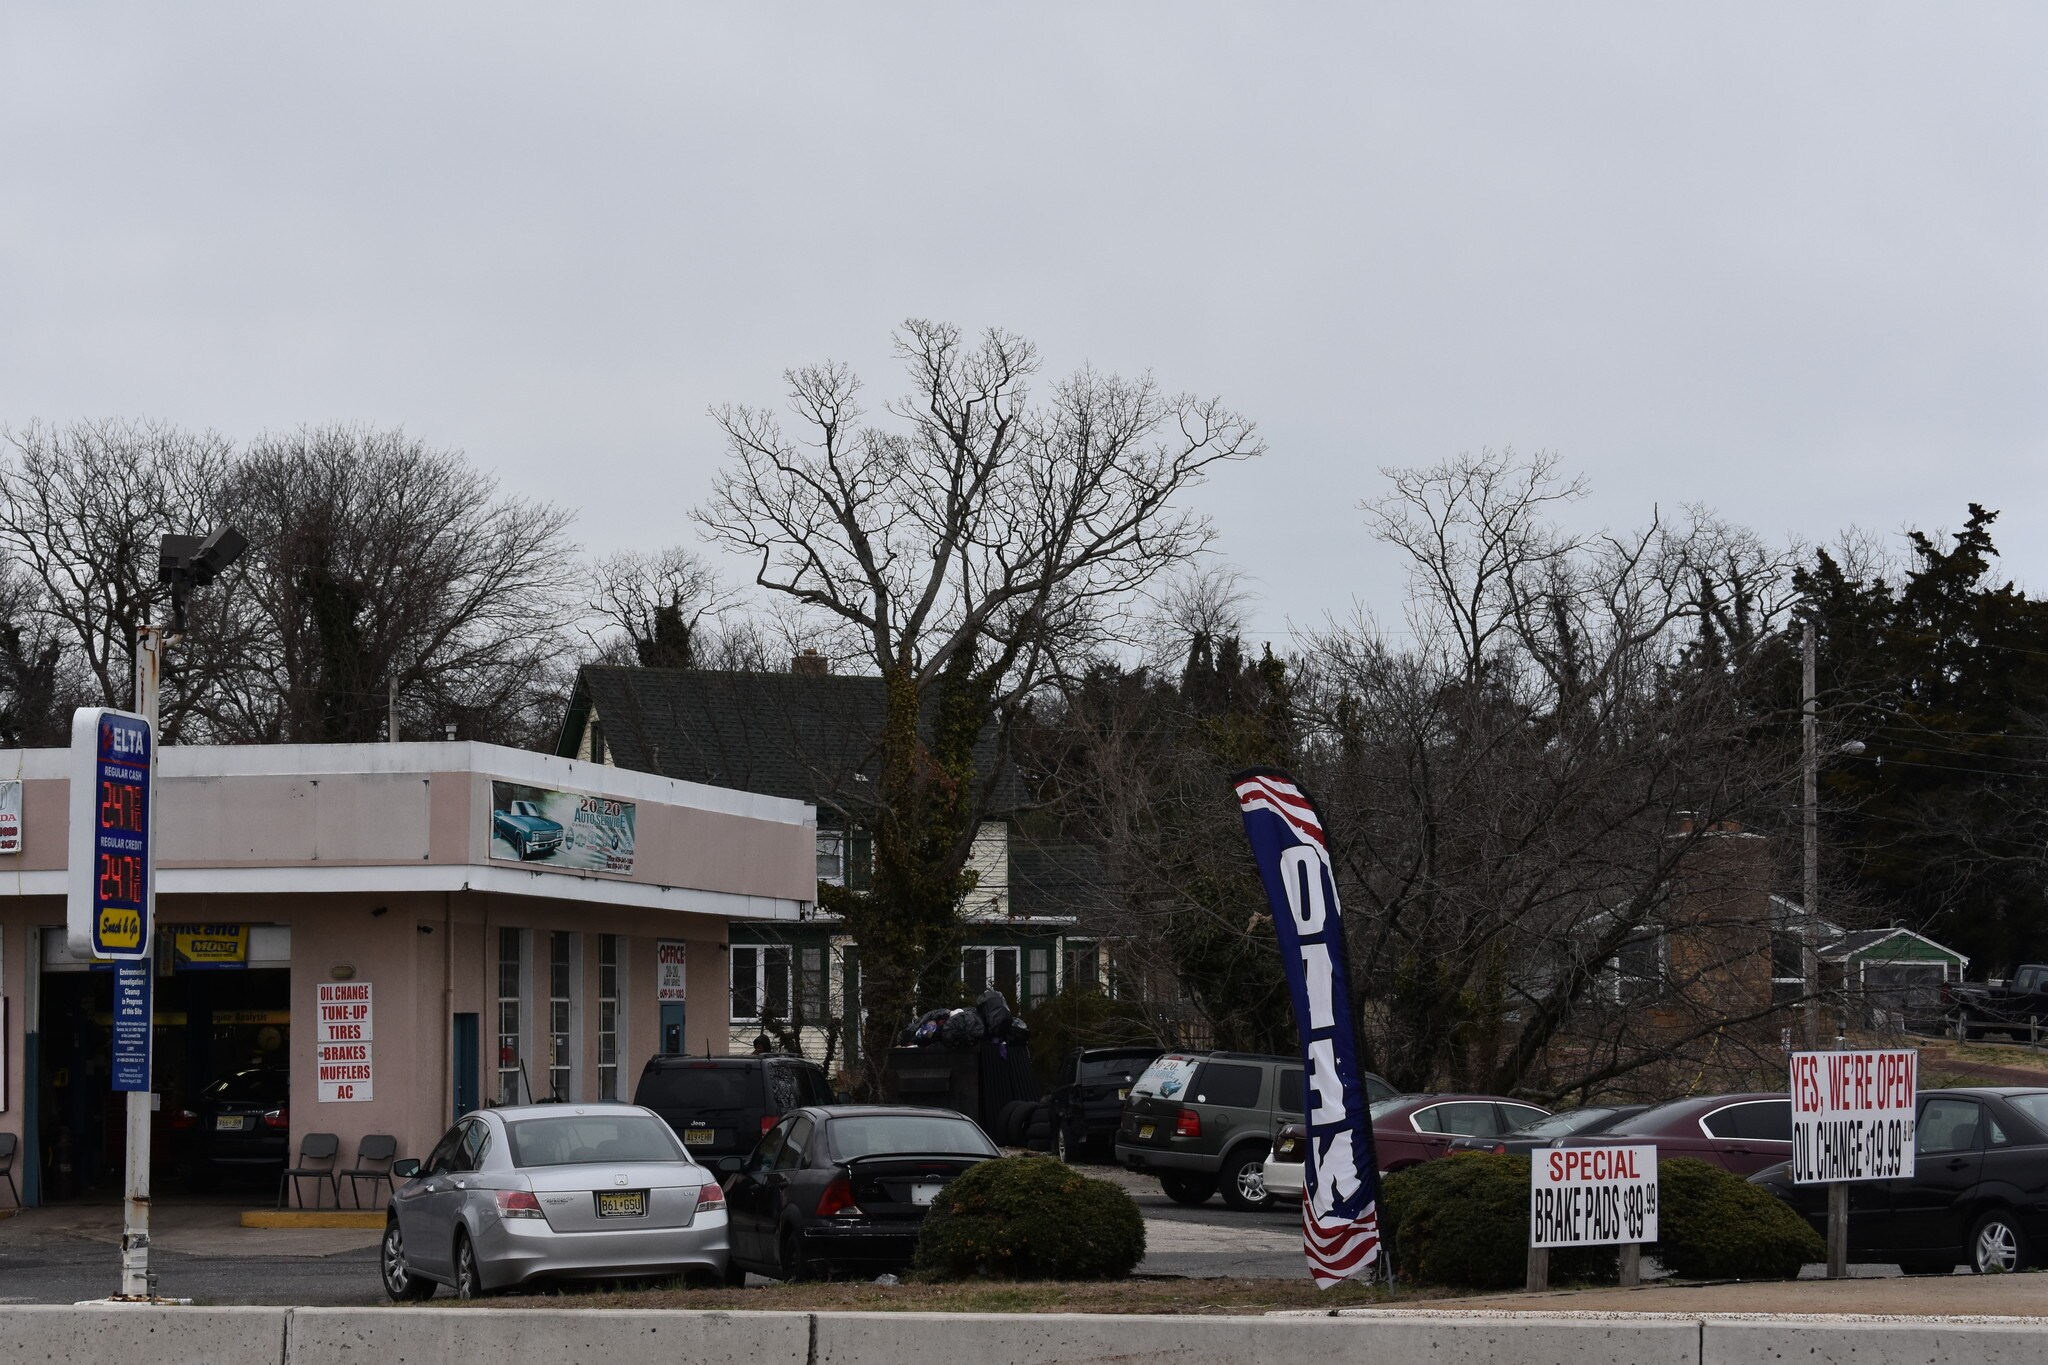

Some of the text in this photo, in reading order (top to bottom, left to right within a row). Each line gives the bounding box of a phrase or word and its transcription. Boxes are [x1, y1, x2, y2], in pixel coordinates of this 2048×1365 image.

[104, 766, 142, 781] REGULAR CASH
[580, 798, 620, 816] 20-20
[100, 836, 142, 851] REGULAR CREDIT
[660, 944, 685, 965] OFFICE
[120, 968, 146, 976] Environmental
[120, 978, 144, 986] Investigation
[124, 988, 140, 997] Cleanup
[320, 985, 369, 1001] OIL CHANGE
[322, 1005, 368, 1020] TUNE-UP
[328, 1025, 361, 1040] TIRES
[324, 1046, 366, 1060] BRAKES
[320, 1065, 370, 1080] MUFFLERS
[338, 1085, 354, 1100] AC
[1791, 1054, 1914, 1117] YES, WE'RE OPEN
[1794, 1122, 1813, 1182] OIL
[1816, 1120, 1862, 1180] CHANGE
[1866, 1119, 1901, 1177] $19.99
[1550, 1150, 1640, 1182] SPECIAL
[1536, 1183, 1656, 1242] BRAKE PADS $89.99
